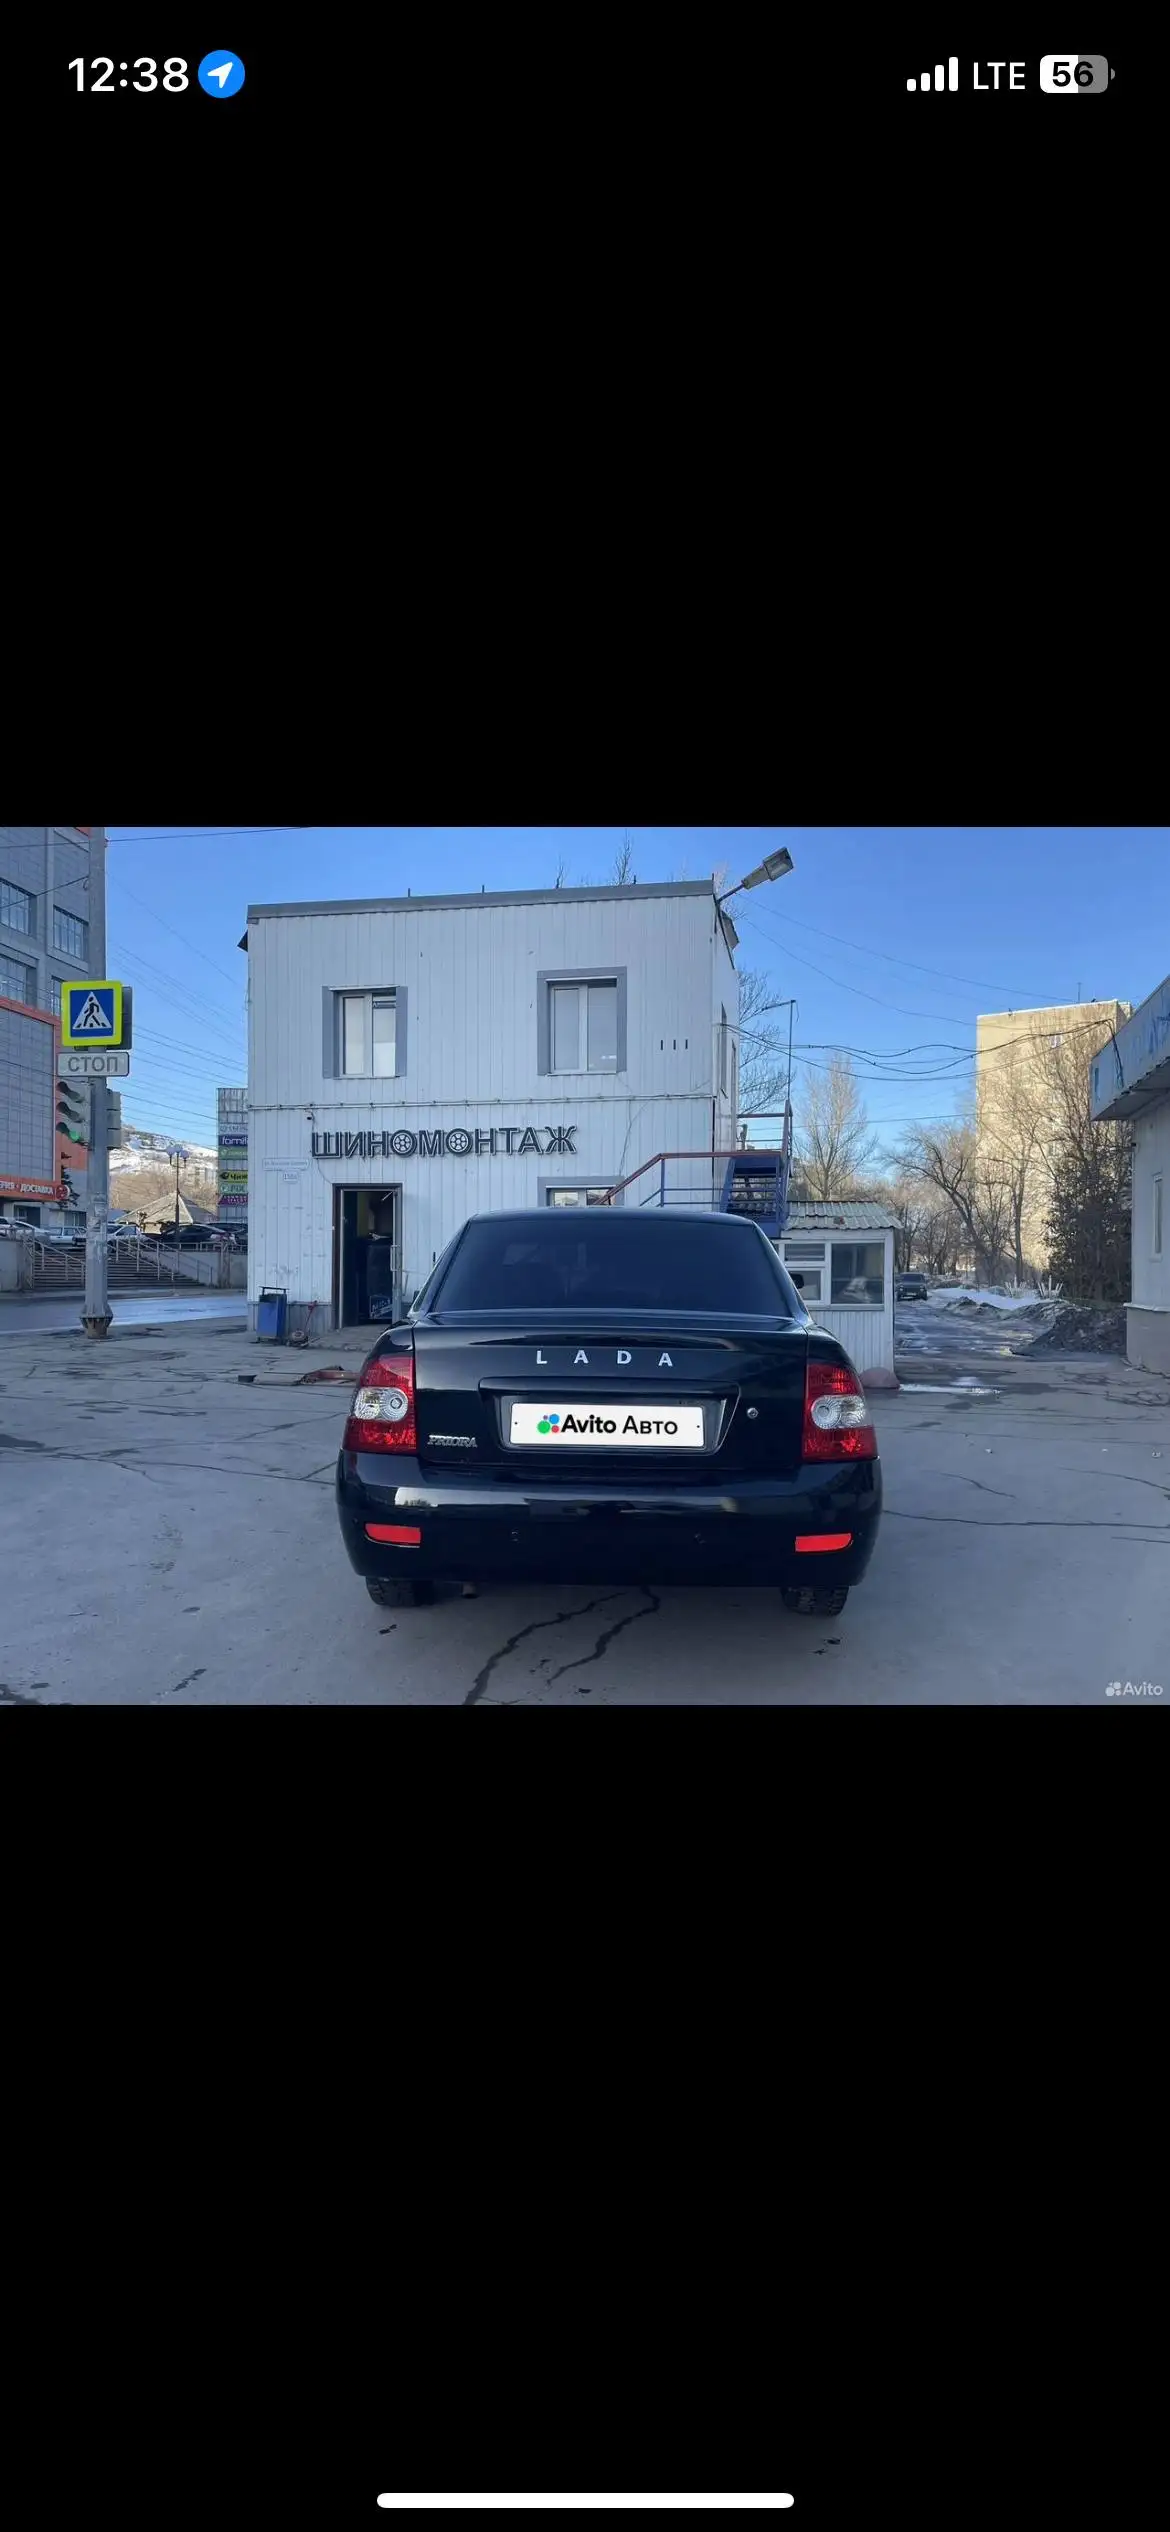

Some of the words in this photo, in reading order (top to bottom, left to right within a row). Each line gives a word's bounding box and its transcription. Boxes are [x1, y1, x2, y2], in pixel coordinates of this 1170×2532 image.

[68, 1056, 118, 1072] СТОП
[222, 1136, 248, 1145] famil
[311, 1126, 577, 1159] ШИНОМОНТАЖ
[536, 1350, 673, 1367] LADA
[427, 1434, 478, 1448] PRIORA
